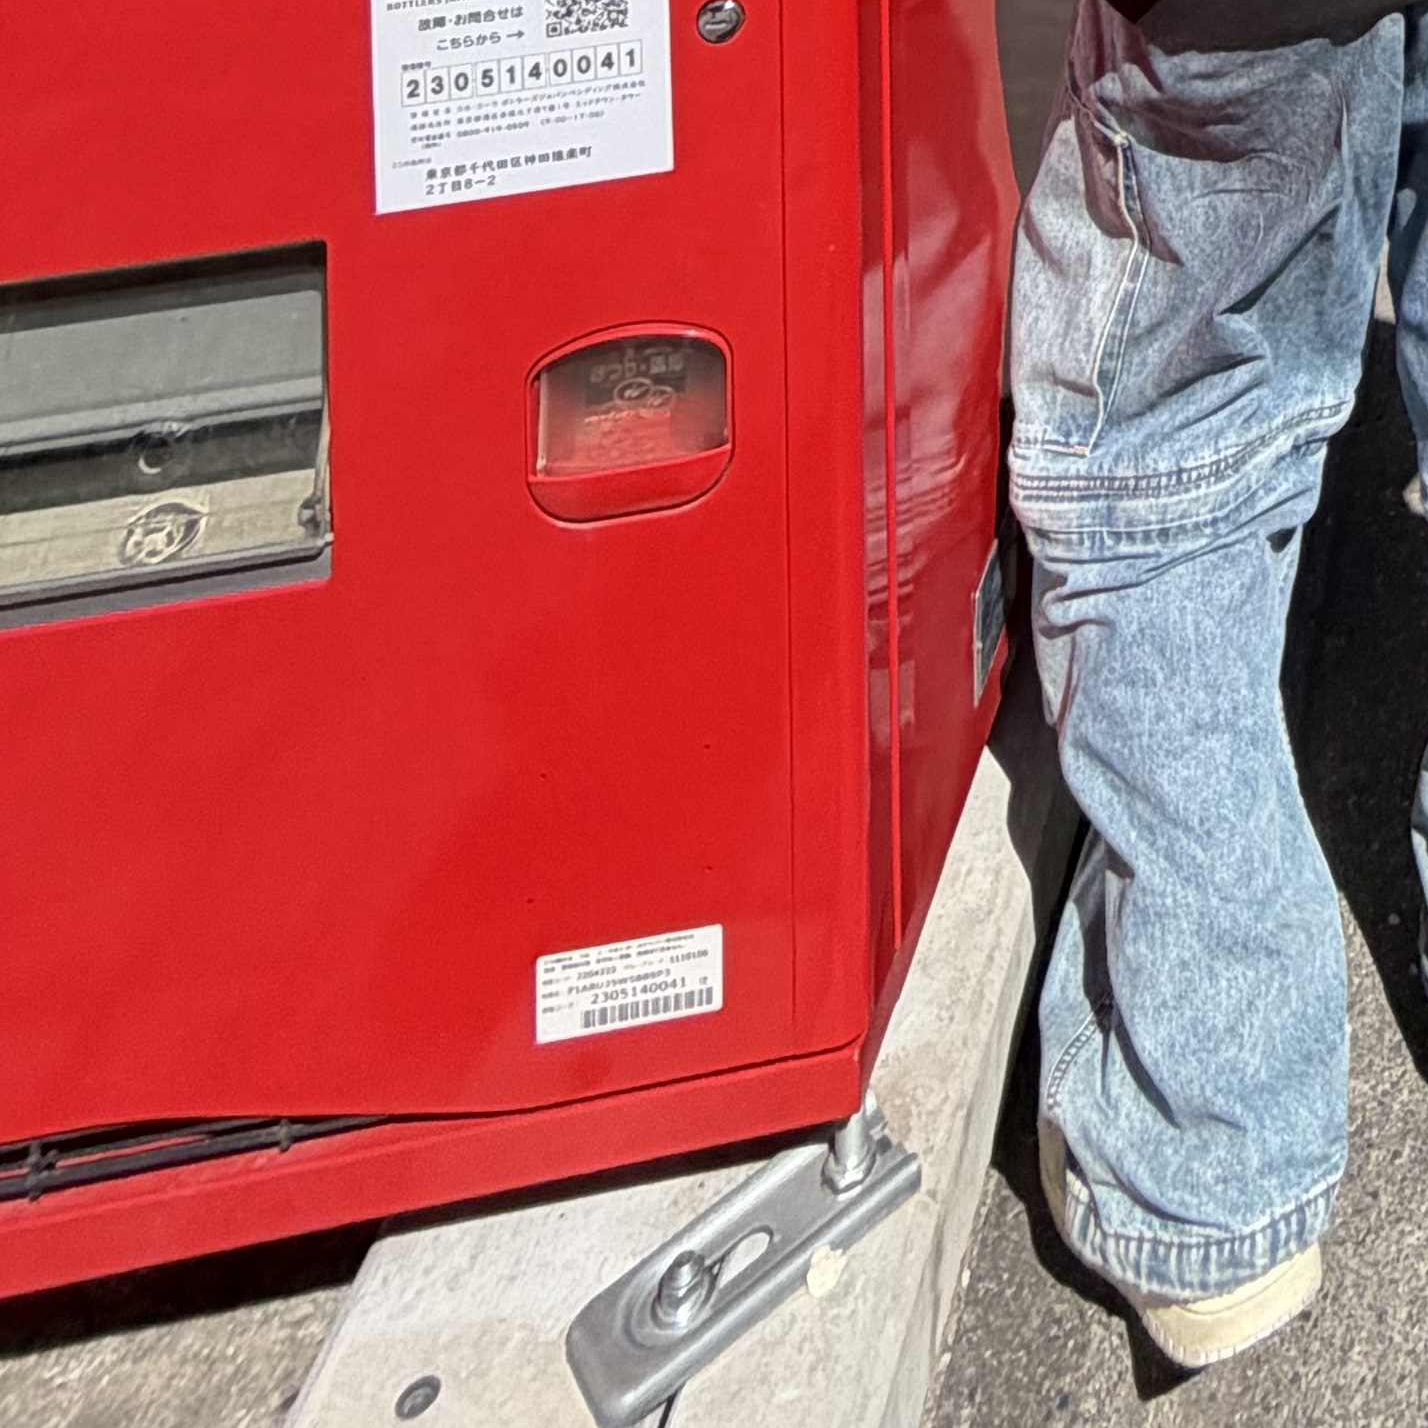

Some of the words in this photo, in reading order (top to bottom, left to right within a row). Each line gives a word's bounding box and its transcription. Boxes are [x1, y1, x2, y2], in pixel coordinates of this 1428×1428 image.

[436, 31, 502, 52] こちらから
[590, 975, 688, 1005] 2305140041
